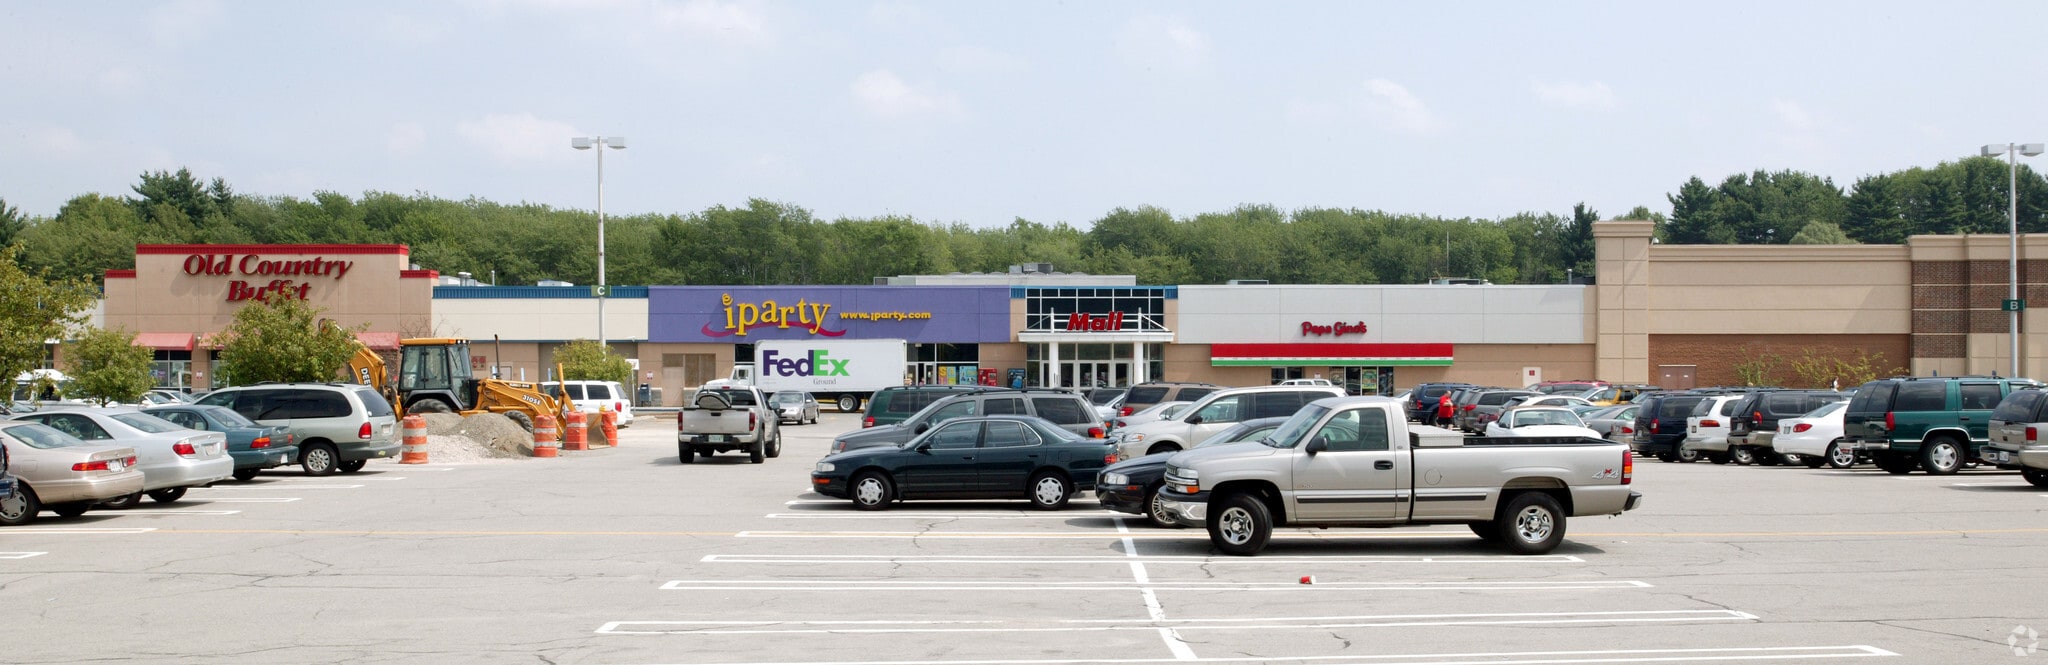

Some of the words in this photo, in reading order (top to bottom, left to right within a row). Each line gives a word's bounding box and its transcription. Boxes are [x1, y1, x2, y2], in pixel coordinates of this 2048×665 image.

[183, 254, 234, 276] Old
[239, 254, 353, 280] Country
[597, 286, 605, 296] C
[721, 293, 831, 335] iparty
[839, 311, 931, 321] www.iparty.com
[2010, 301, 2019, 310] B
[1066, 311, 1124, 331] Mall
[1301, 321, 1332, 337] Papa
[762, 349, 850, 377] FedEx
